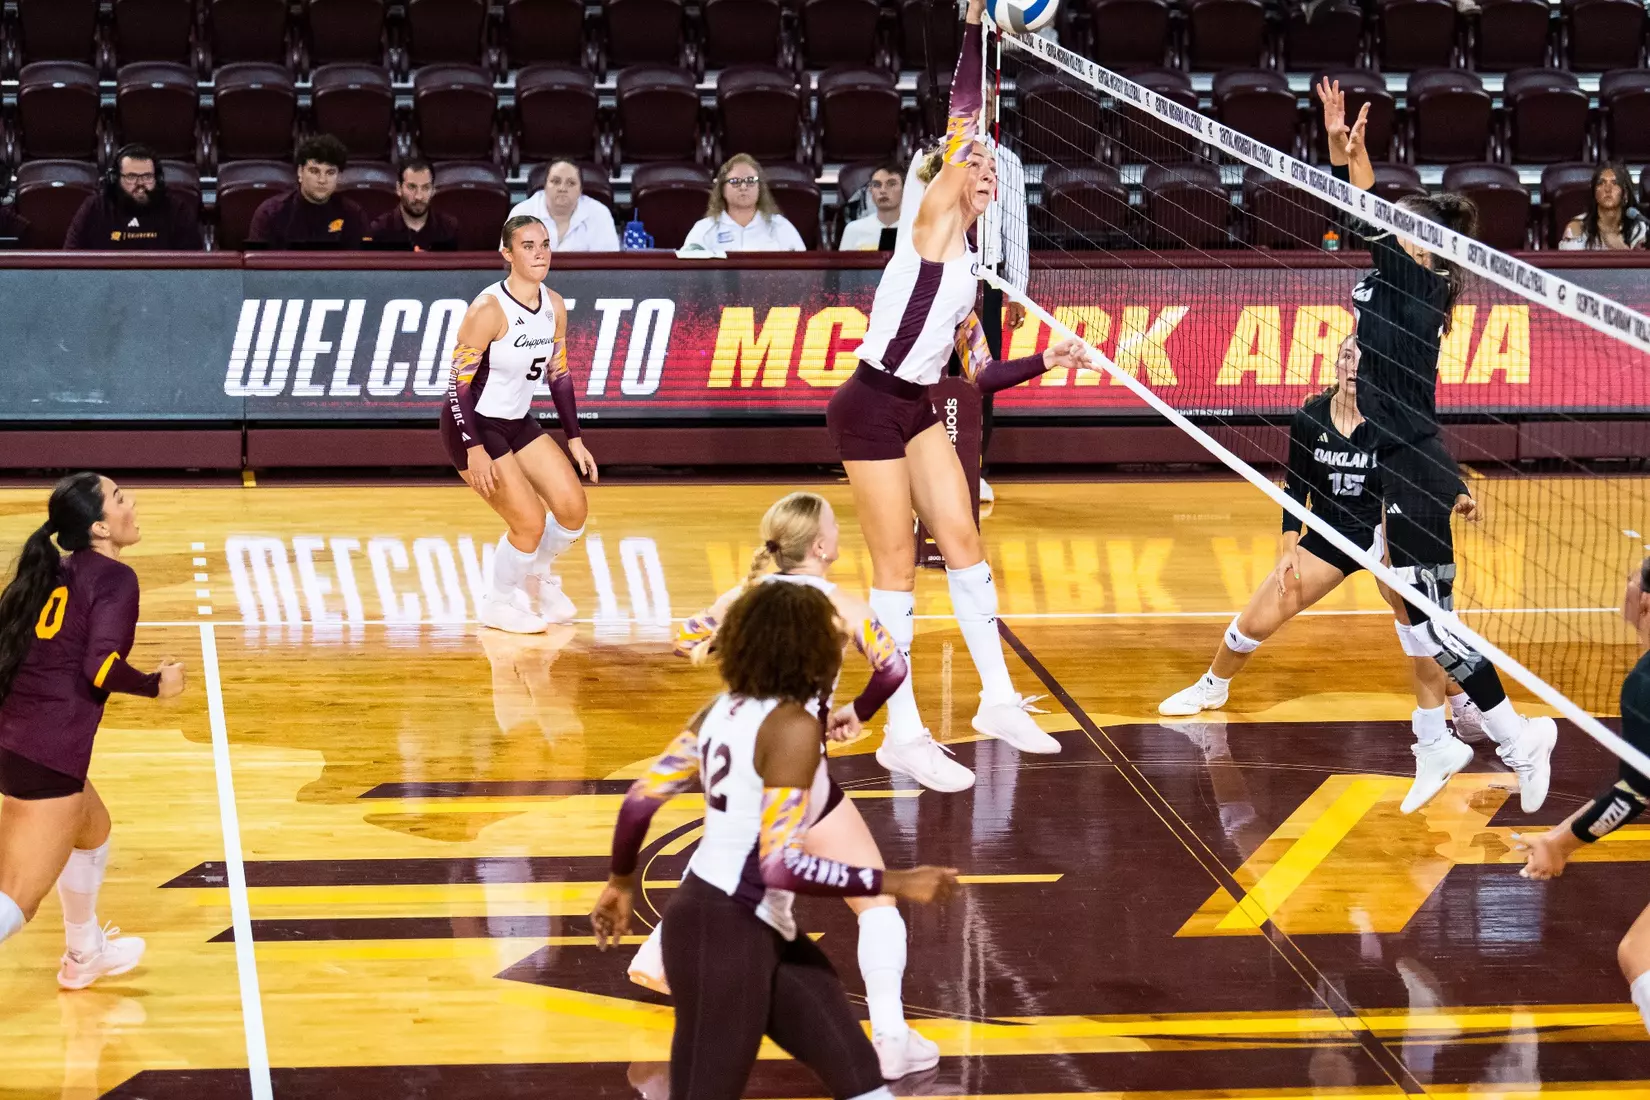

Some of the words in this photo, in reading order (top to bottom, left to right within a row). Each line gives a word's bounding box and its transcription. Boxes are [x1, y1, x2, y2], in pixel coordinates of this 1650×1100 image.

[224, 299, 575, 396] WELCO
[586, 299, 675, 395] TO
[1216, 305, 1530, 385] ARA
[526, 356, 547, 381] 5
[538, 412, 600, 420] DAKNICS
[944, 398, 959, 443] sports
[1313, 447, 1378, 469] OAKLAN
[1328, 472, 1366, 496] 15
[35, 585, 69, 640] 0
[701, 736, 732, 813] 12
